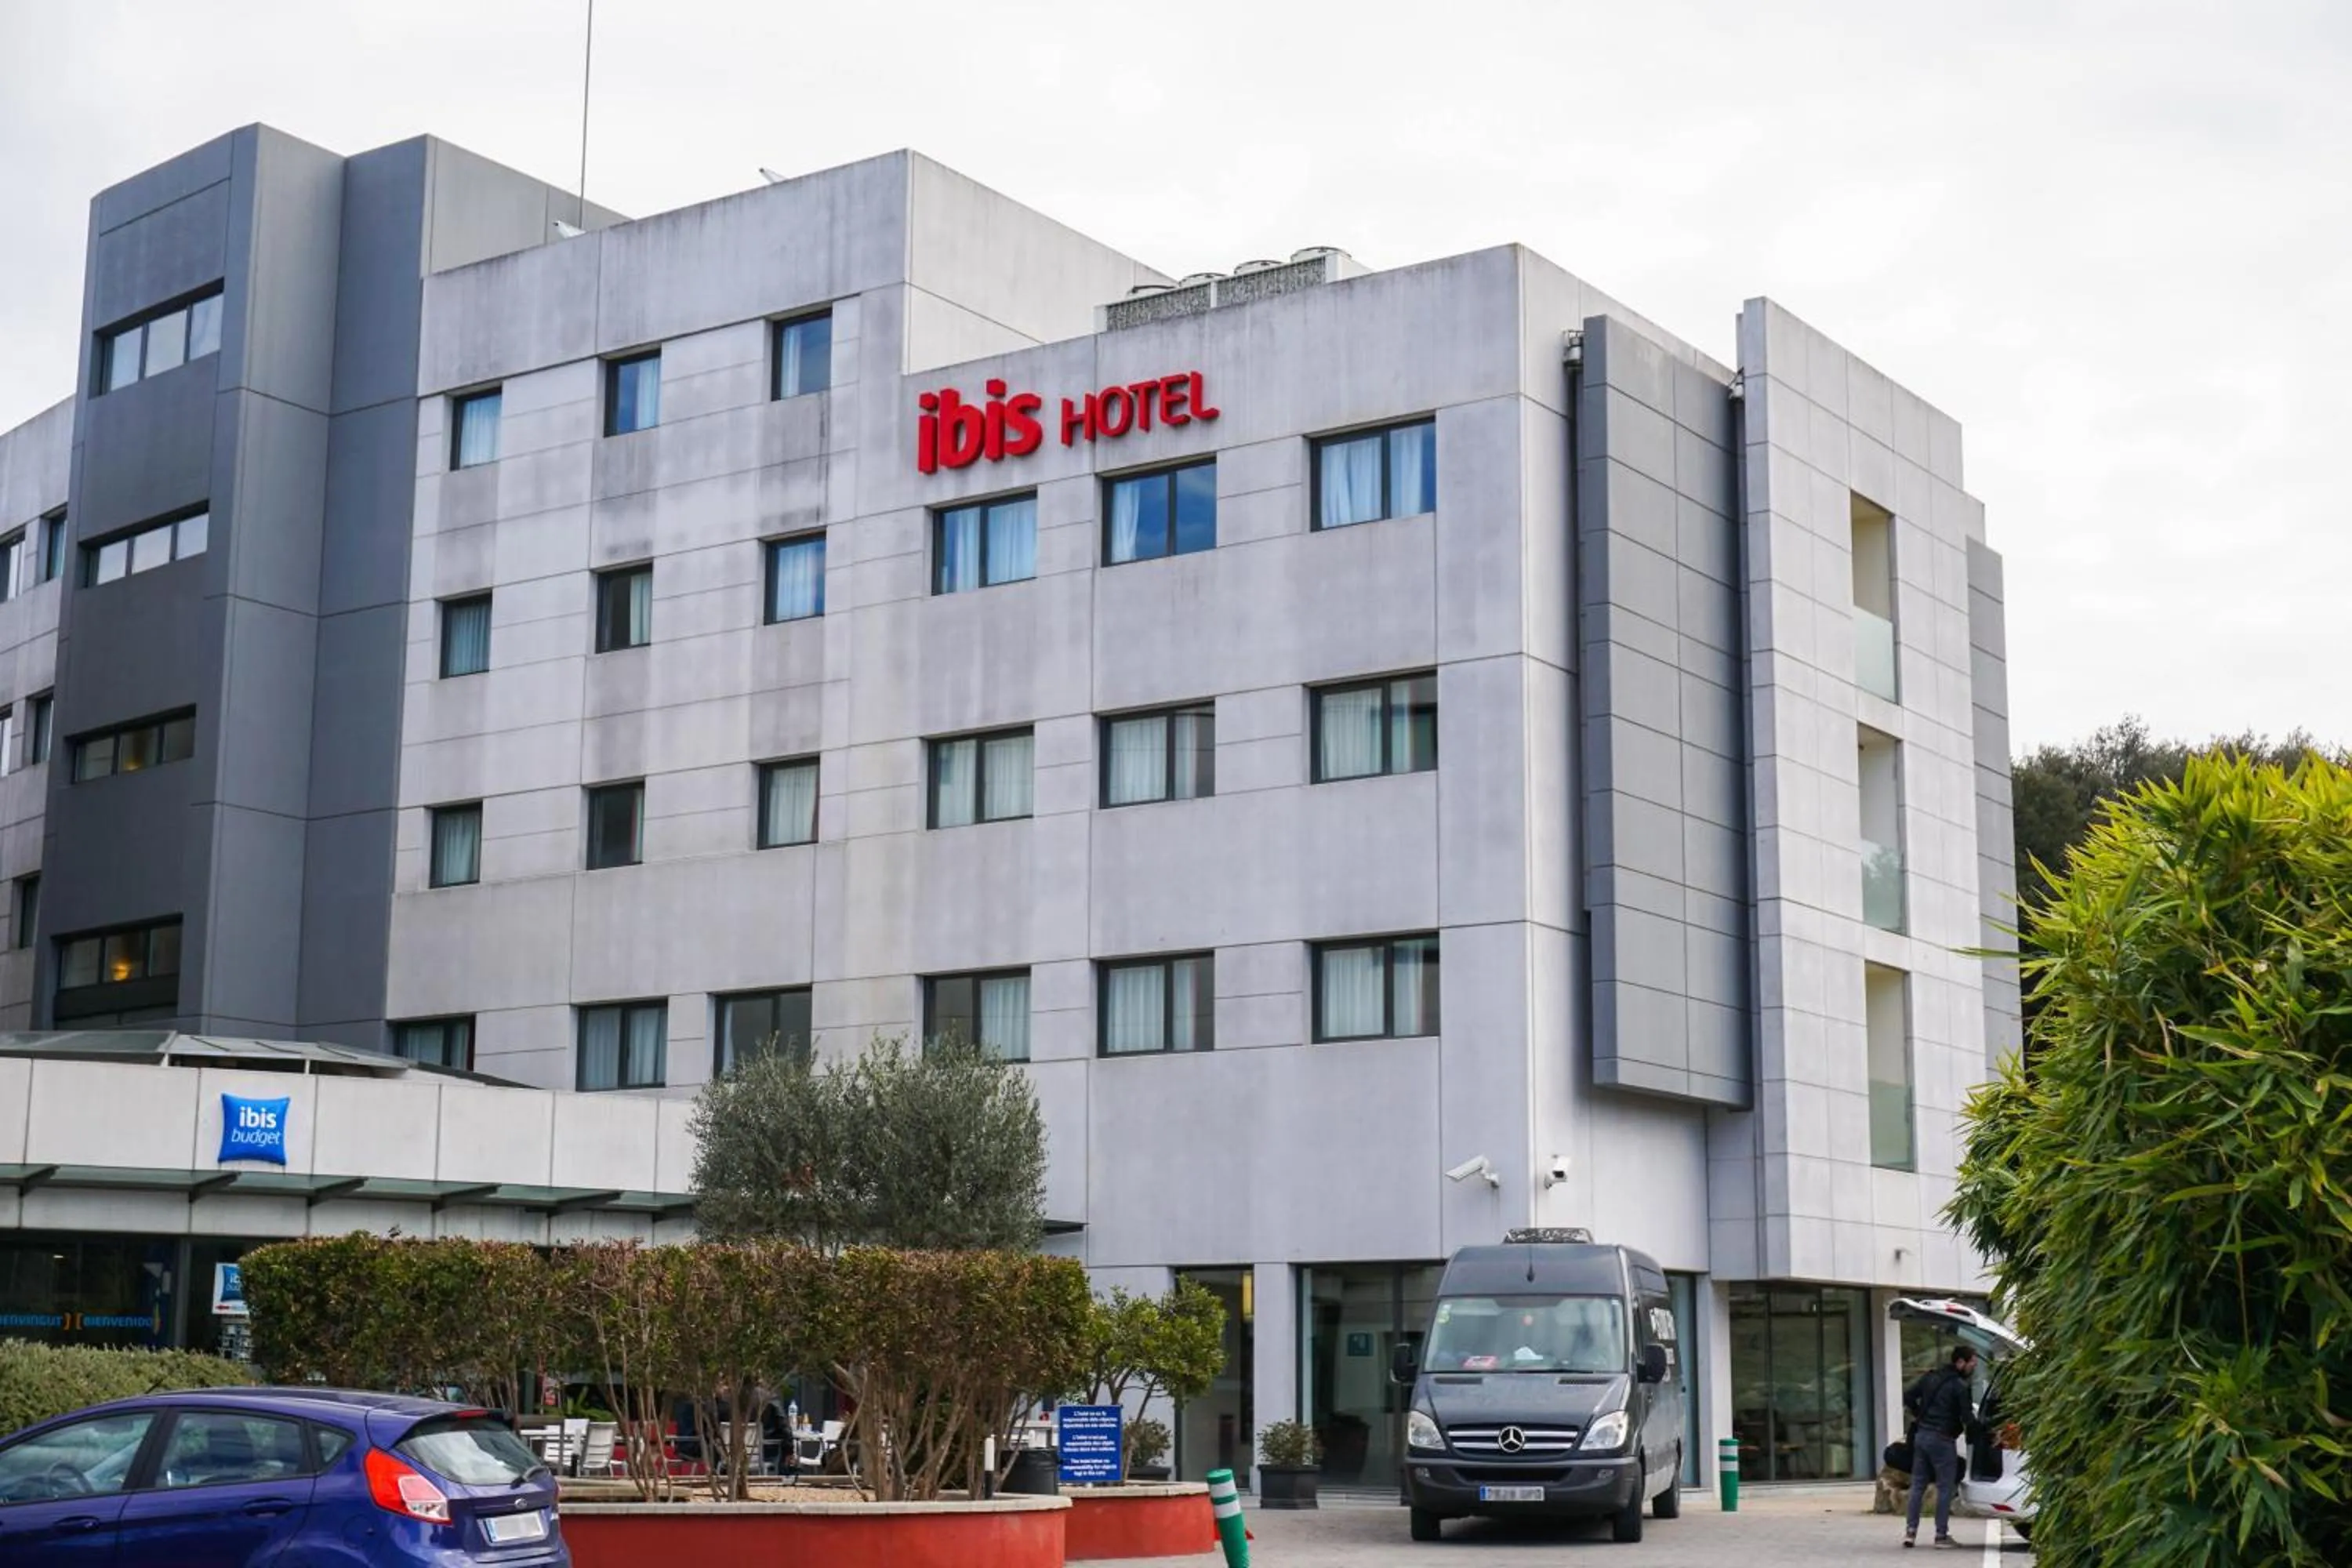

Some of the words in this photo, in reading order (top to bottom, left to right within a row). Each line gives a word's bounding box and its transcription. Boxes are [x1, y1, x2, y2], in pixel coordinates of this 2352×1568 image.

[918, 379, 1043, 475] ibis
[1060, 370, 1220, 448] HOTEL
[239, 1105, 277, 1128] ibis
[231, 1128, 281, 1147] budget
